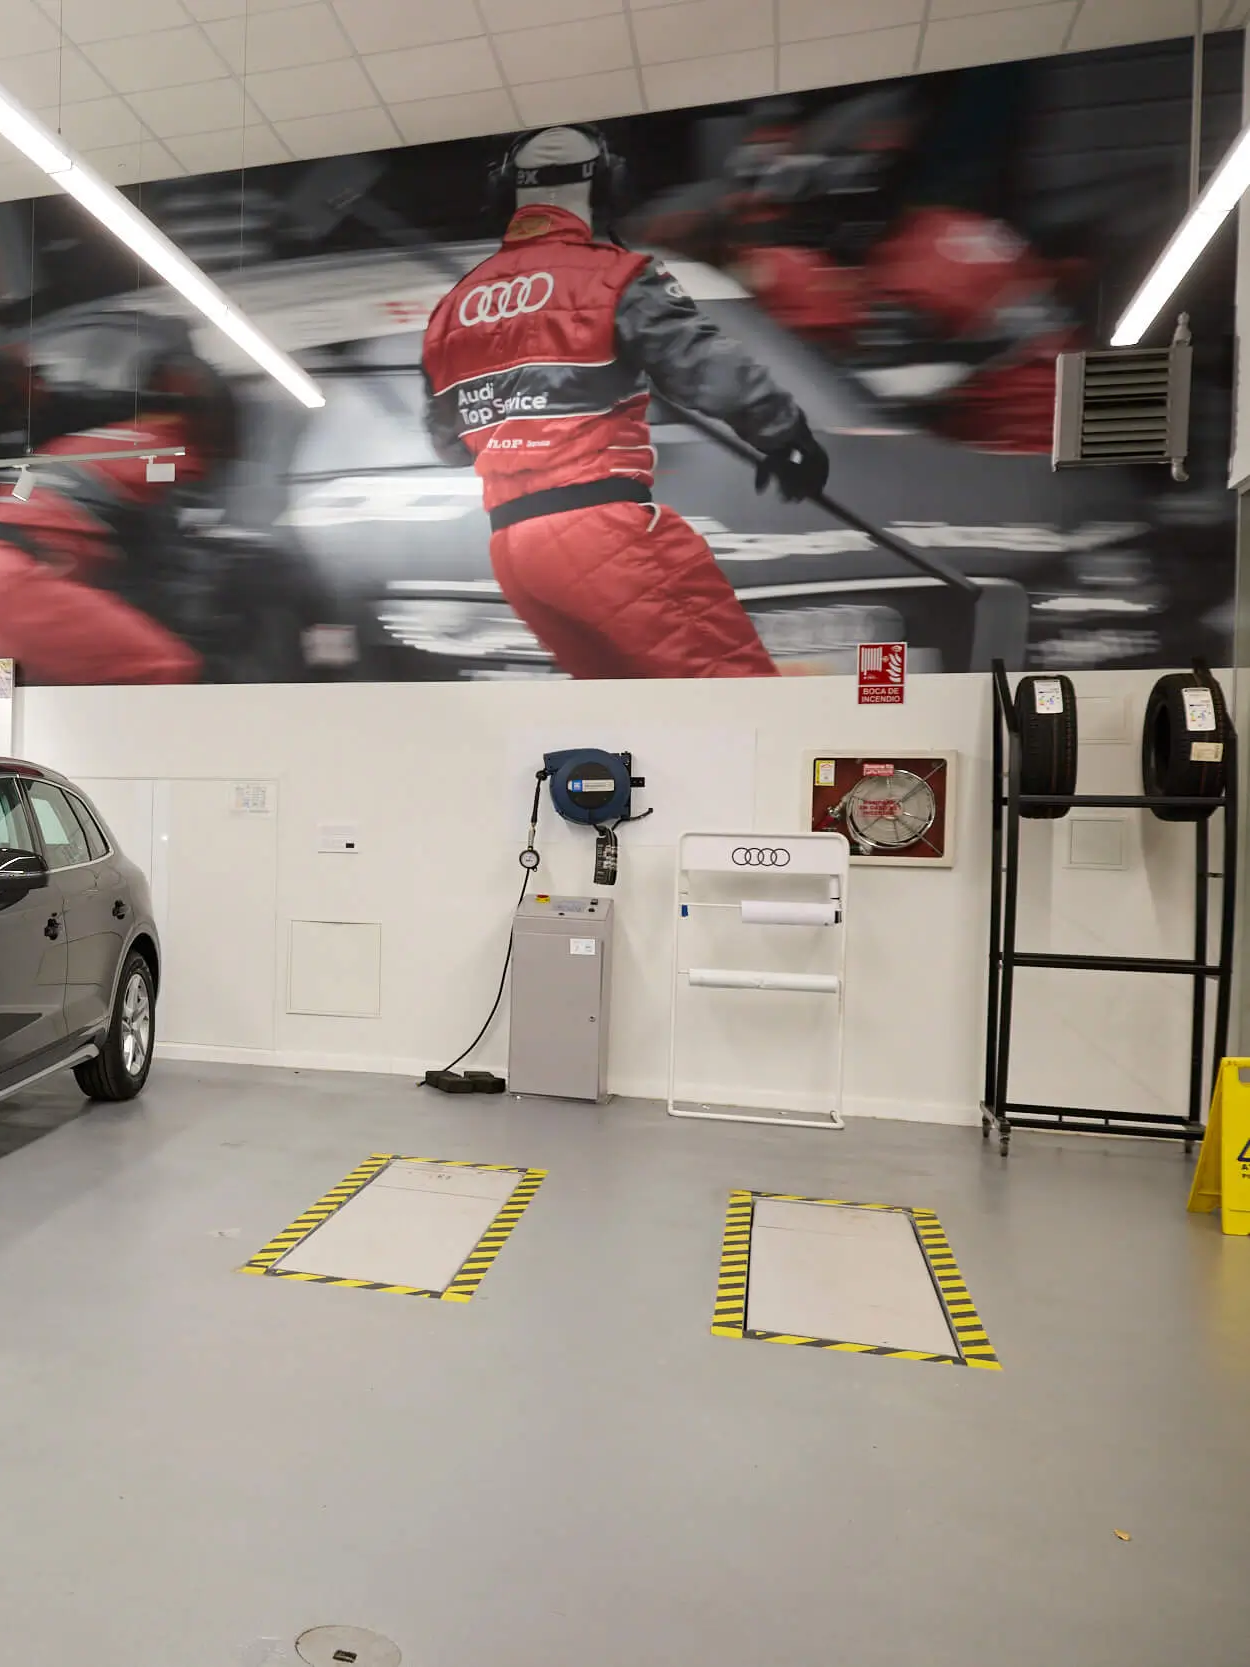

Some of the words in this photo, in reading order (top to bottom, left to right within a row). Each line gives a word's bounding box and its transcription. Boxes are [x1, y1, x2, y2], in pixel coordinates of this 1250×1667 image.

[458, 382, 494, 406] Audi
[459, 407, 493, 425] Top
[863, 687, 886, 695] BOCA
[888, 687, 900, 695] DE
[861, 695, 901, 703] INCENDIO
